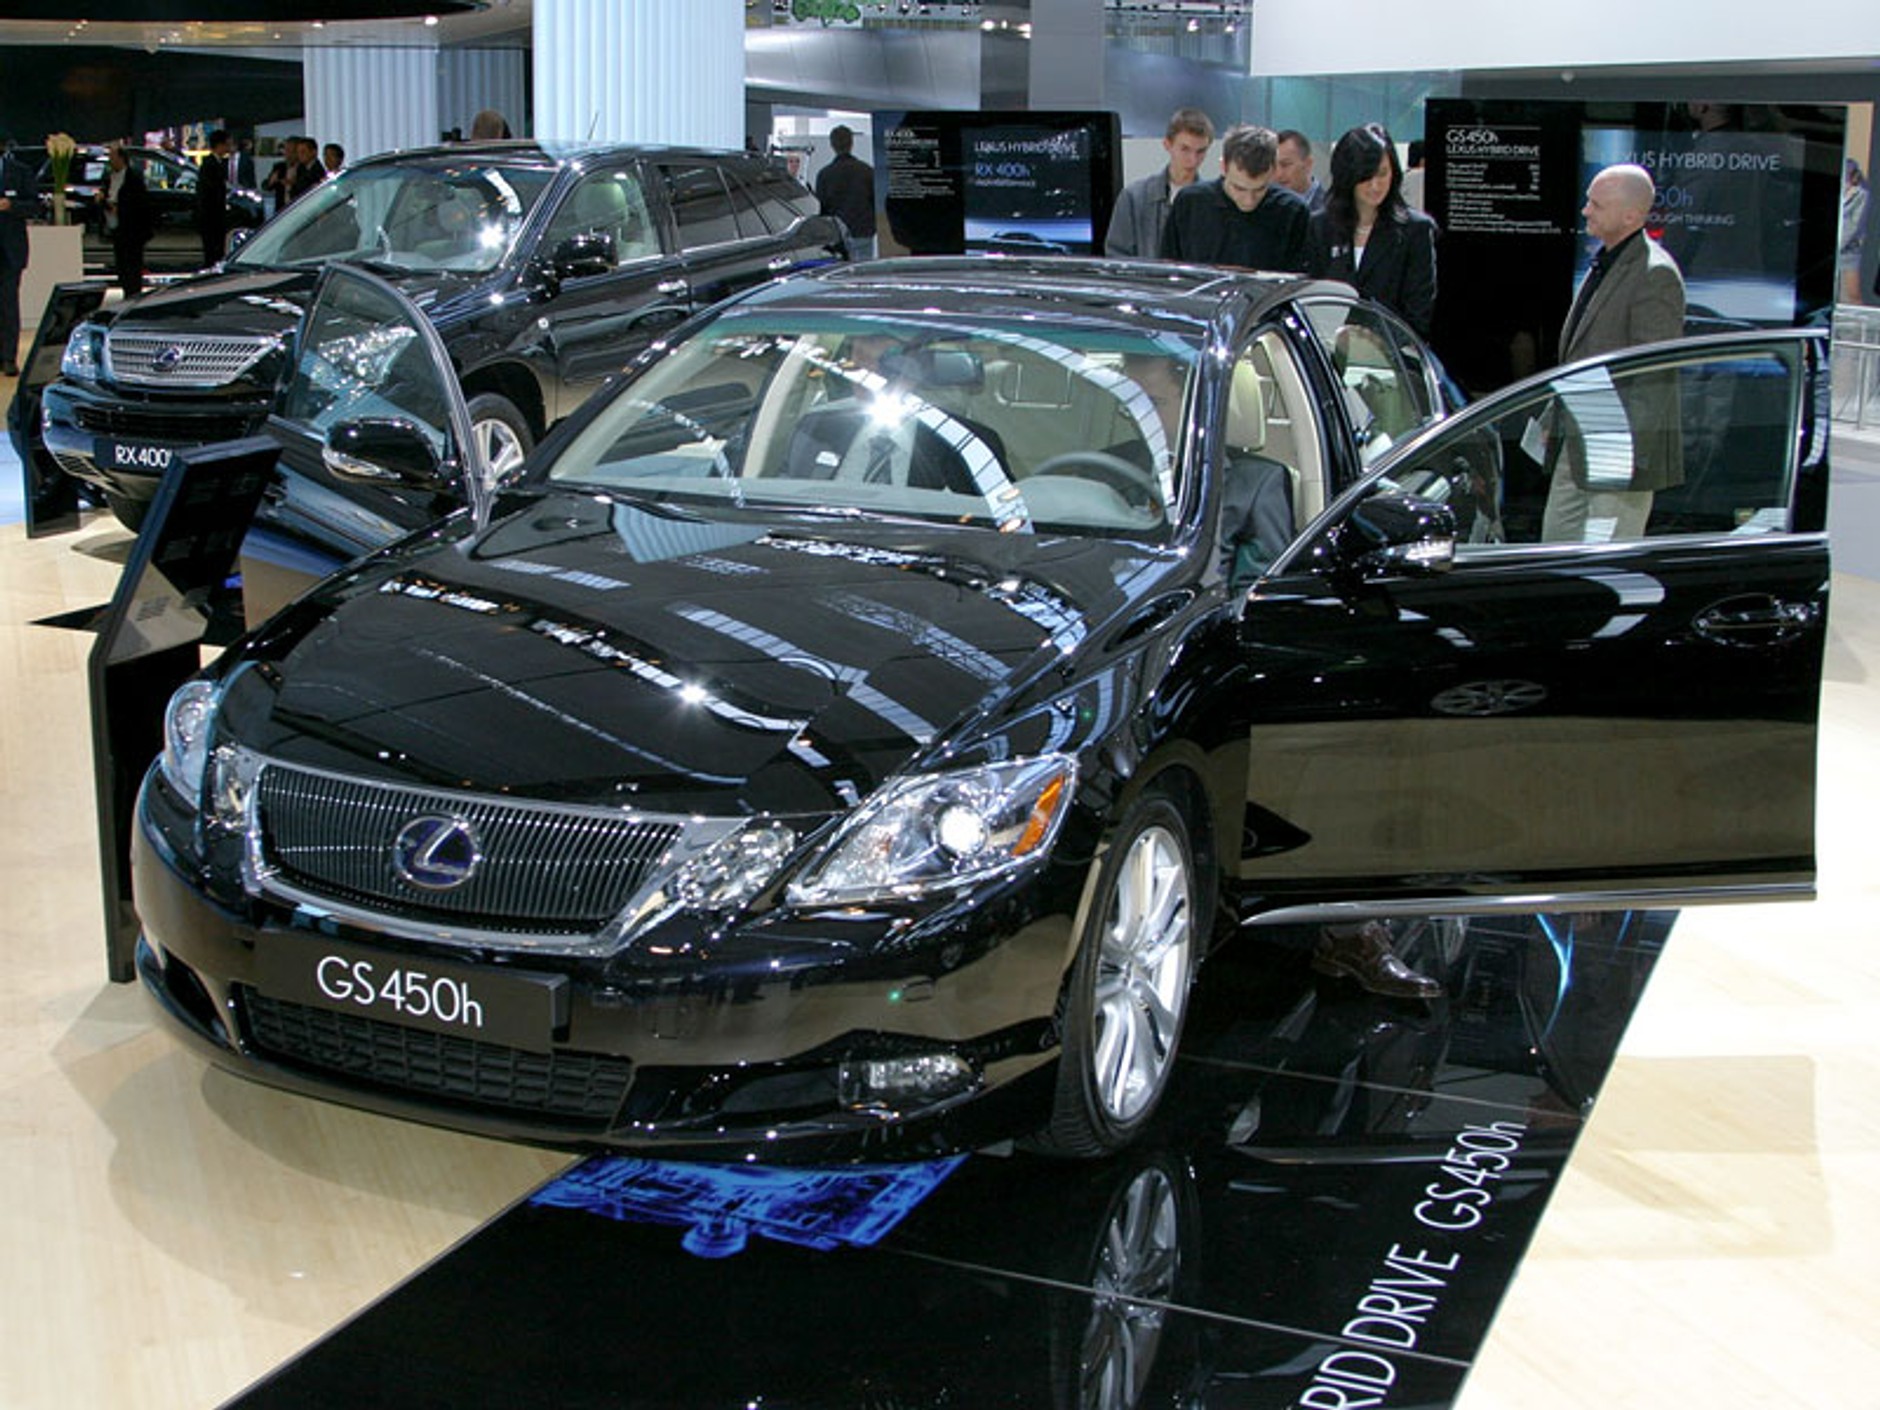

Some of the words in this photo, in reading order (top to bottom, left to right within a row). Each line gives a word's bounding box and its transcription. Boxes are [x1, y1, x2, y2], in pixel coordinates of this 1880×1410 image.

[1659, 152, 1726, 171] HYBRID
[1728, 153, 1782, 171] DRIVE
[1654, 185, 1694, 208] 50h
[316, 955, 484, 1028] GS450h
[1413, 1120, 1528, 1230] GS450h
[1341, 1243, 1460, 1349] DRIVE
[1299, 1351, 1396, 1410] RID
